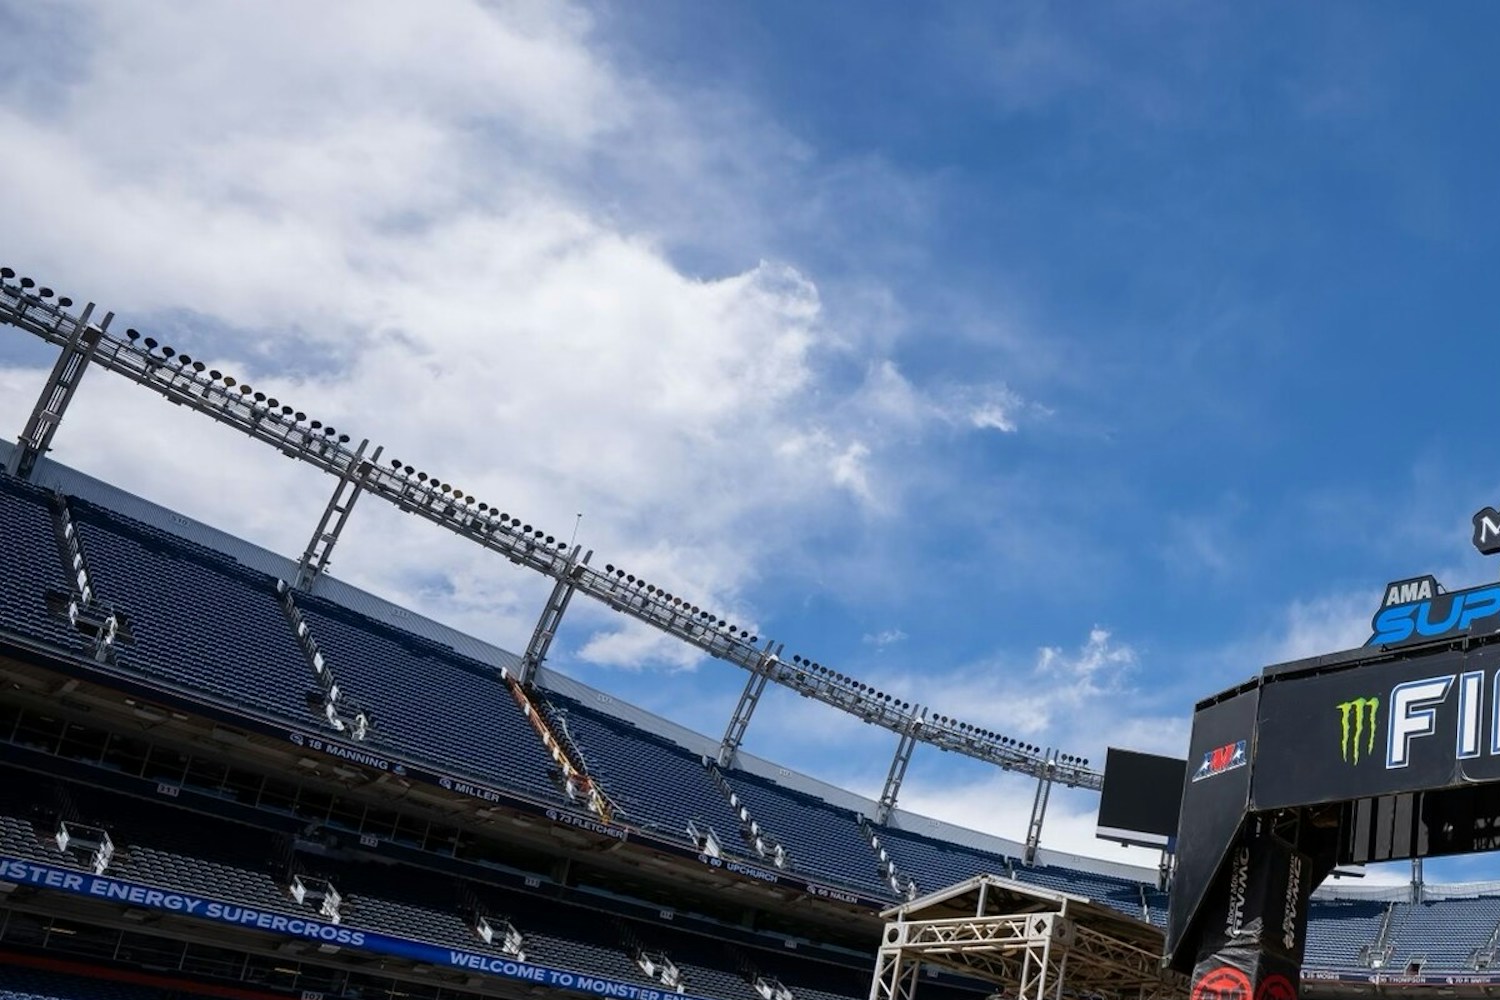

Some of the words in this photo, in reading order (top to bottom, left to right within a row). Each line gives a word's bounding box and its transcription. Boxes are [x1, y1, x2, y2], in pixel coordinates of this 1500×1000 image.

[1386, 580, 1432, 606] AMA
[308, 738, 323, 750] 18
[326, 744, 389, 770] MANNING
[1192, 740, 1247, 779] AMA
[455, 782, 500, 803] MILLER
[559, 814, 573, 825] 73
[572, 817, 624, 839] FLETCHER
[727, 862, 778, 883] UPCHURCH
[90, 878, 203, 914] ENERGY
[205, 902, 365, 947] SUPERCROSS
[450, 950, 545, 984] WELCOME
[549, 969, 575, 988] TO
